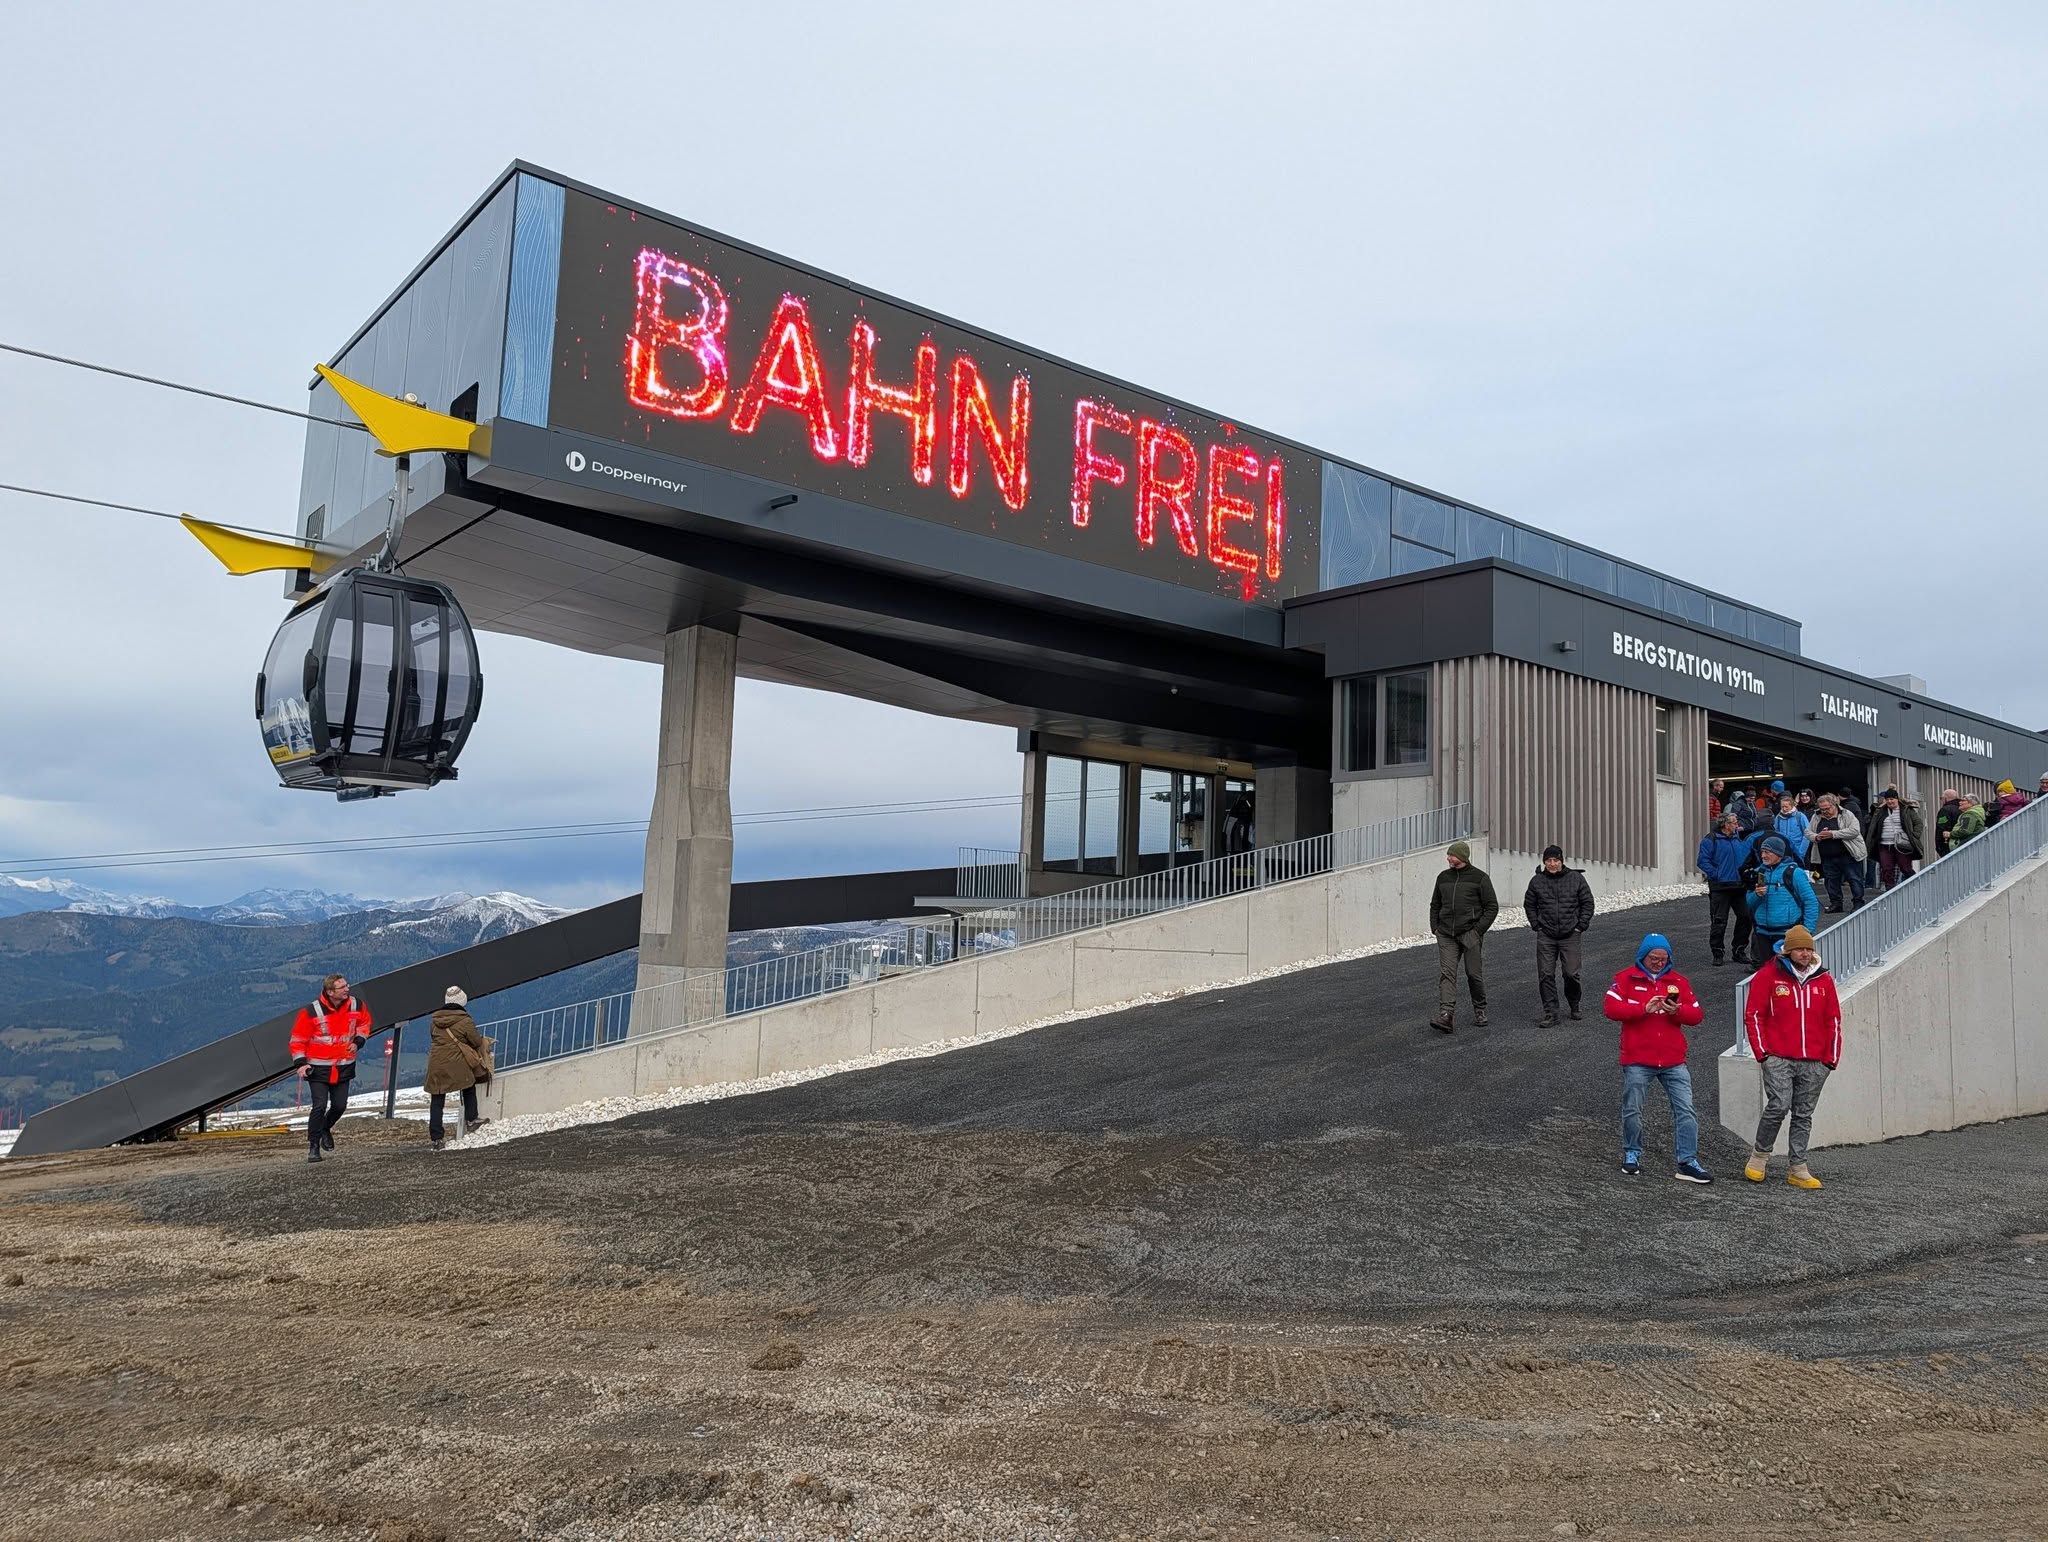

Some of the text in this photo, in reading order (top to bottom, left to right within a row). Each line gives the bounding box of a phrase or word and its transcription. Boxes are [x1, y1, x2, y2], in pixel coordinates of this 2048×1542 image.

[625, 247, 1285, 580] BAHN FREI
[592, 461, 687, 492] Doppelmayr
[1612, 631, 1765, 695] BERGSTATION 1911m
[1820, 692, 1879, 727] TALFAHRT
[1923, 723, 1993, 759] KANZELBAHN II
